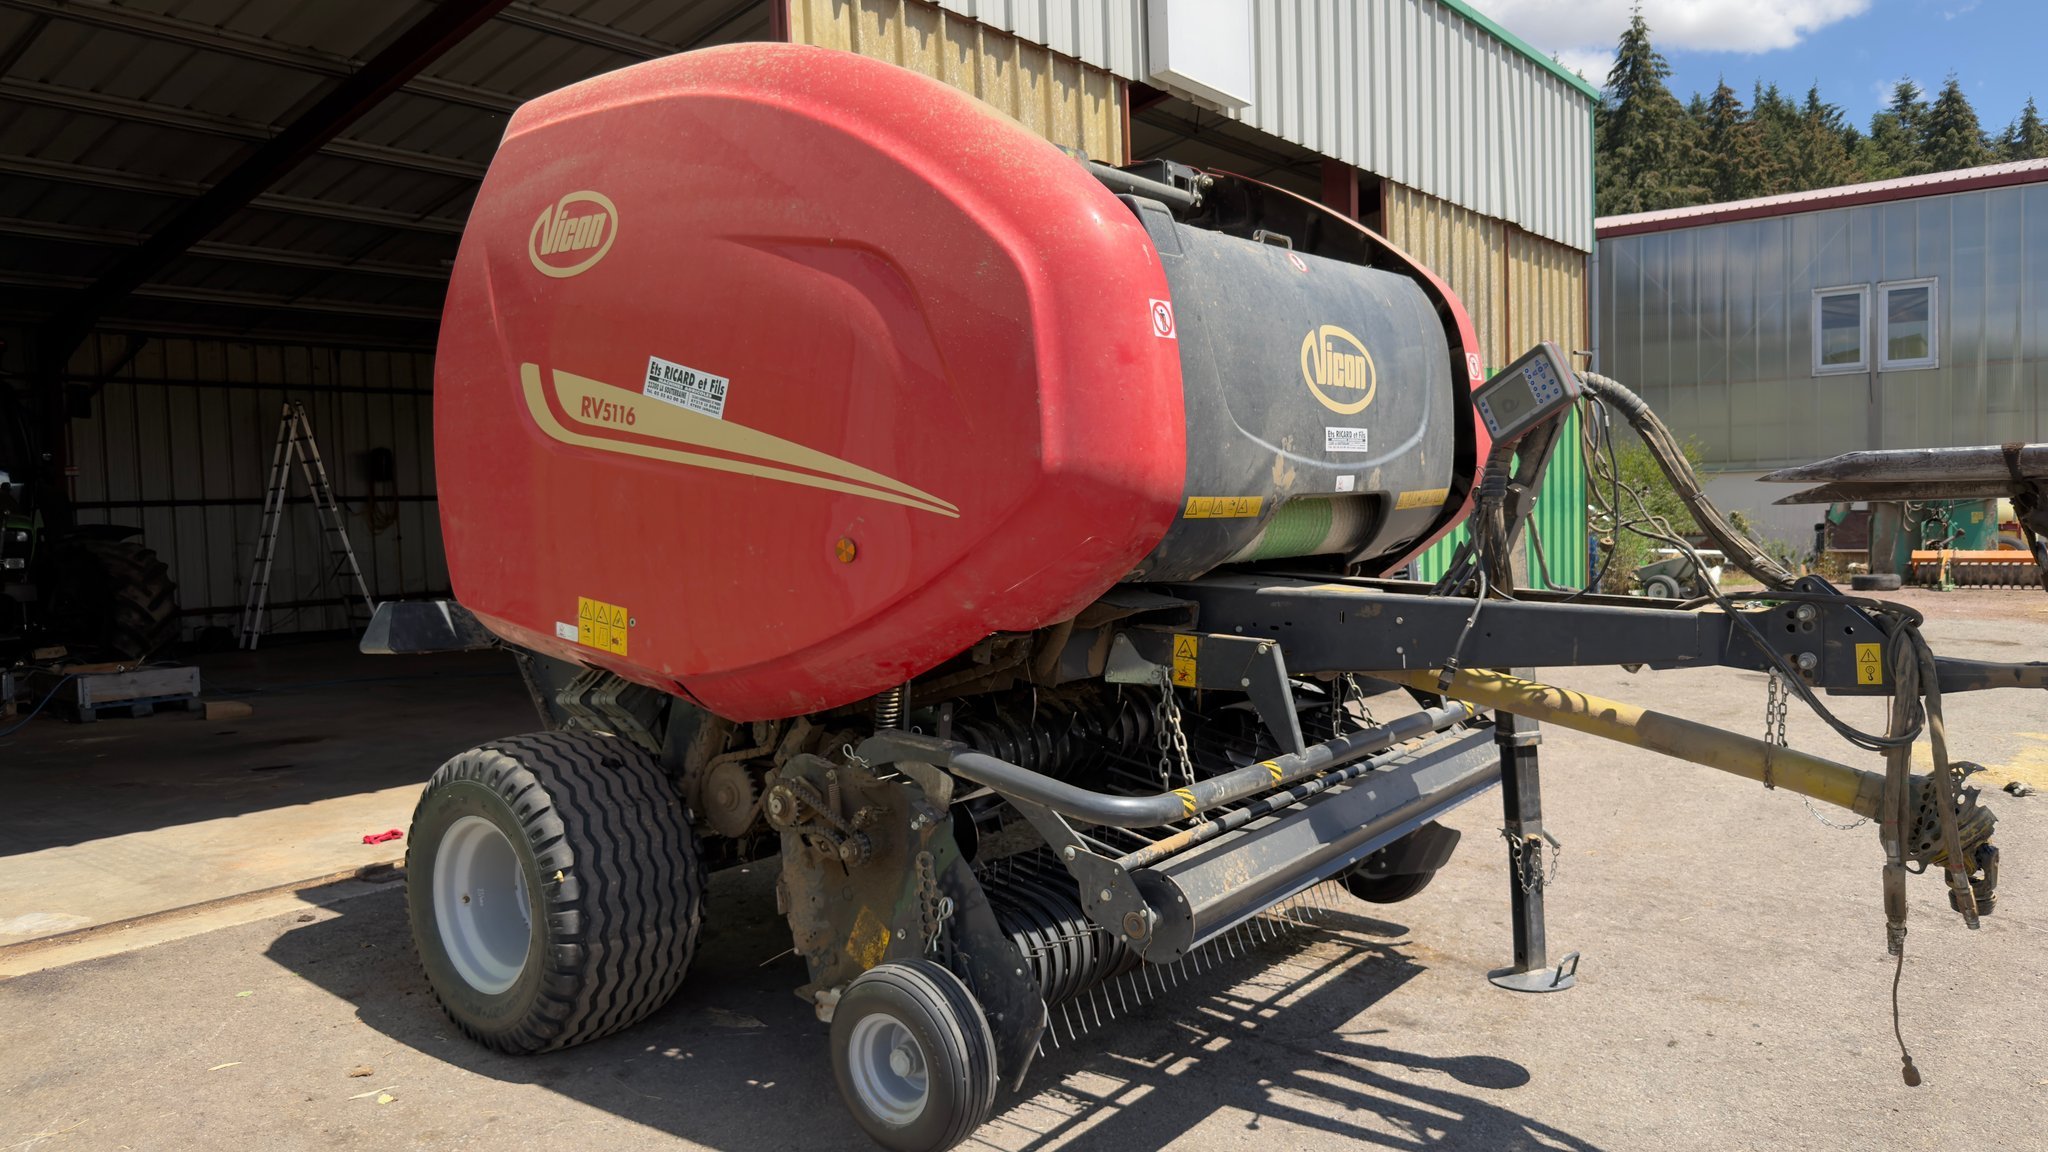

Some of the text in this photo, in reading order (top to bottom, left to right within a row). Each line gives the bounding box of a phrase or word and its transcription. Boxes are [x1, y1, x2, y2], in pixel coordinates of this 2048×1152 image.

[533, 197, 612, 265] Vicon
[650, 361, 725, 396] Ets RICARD et Fils
[1307, 326, 1371, 402] Vicon
[581, 395, 636, 426] RV5116
